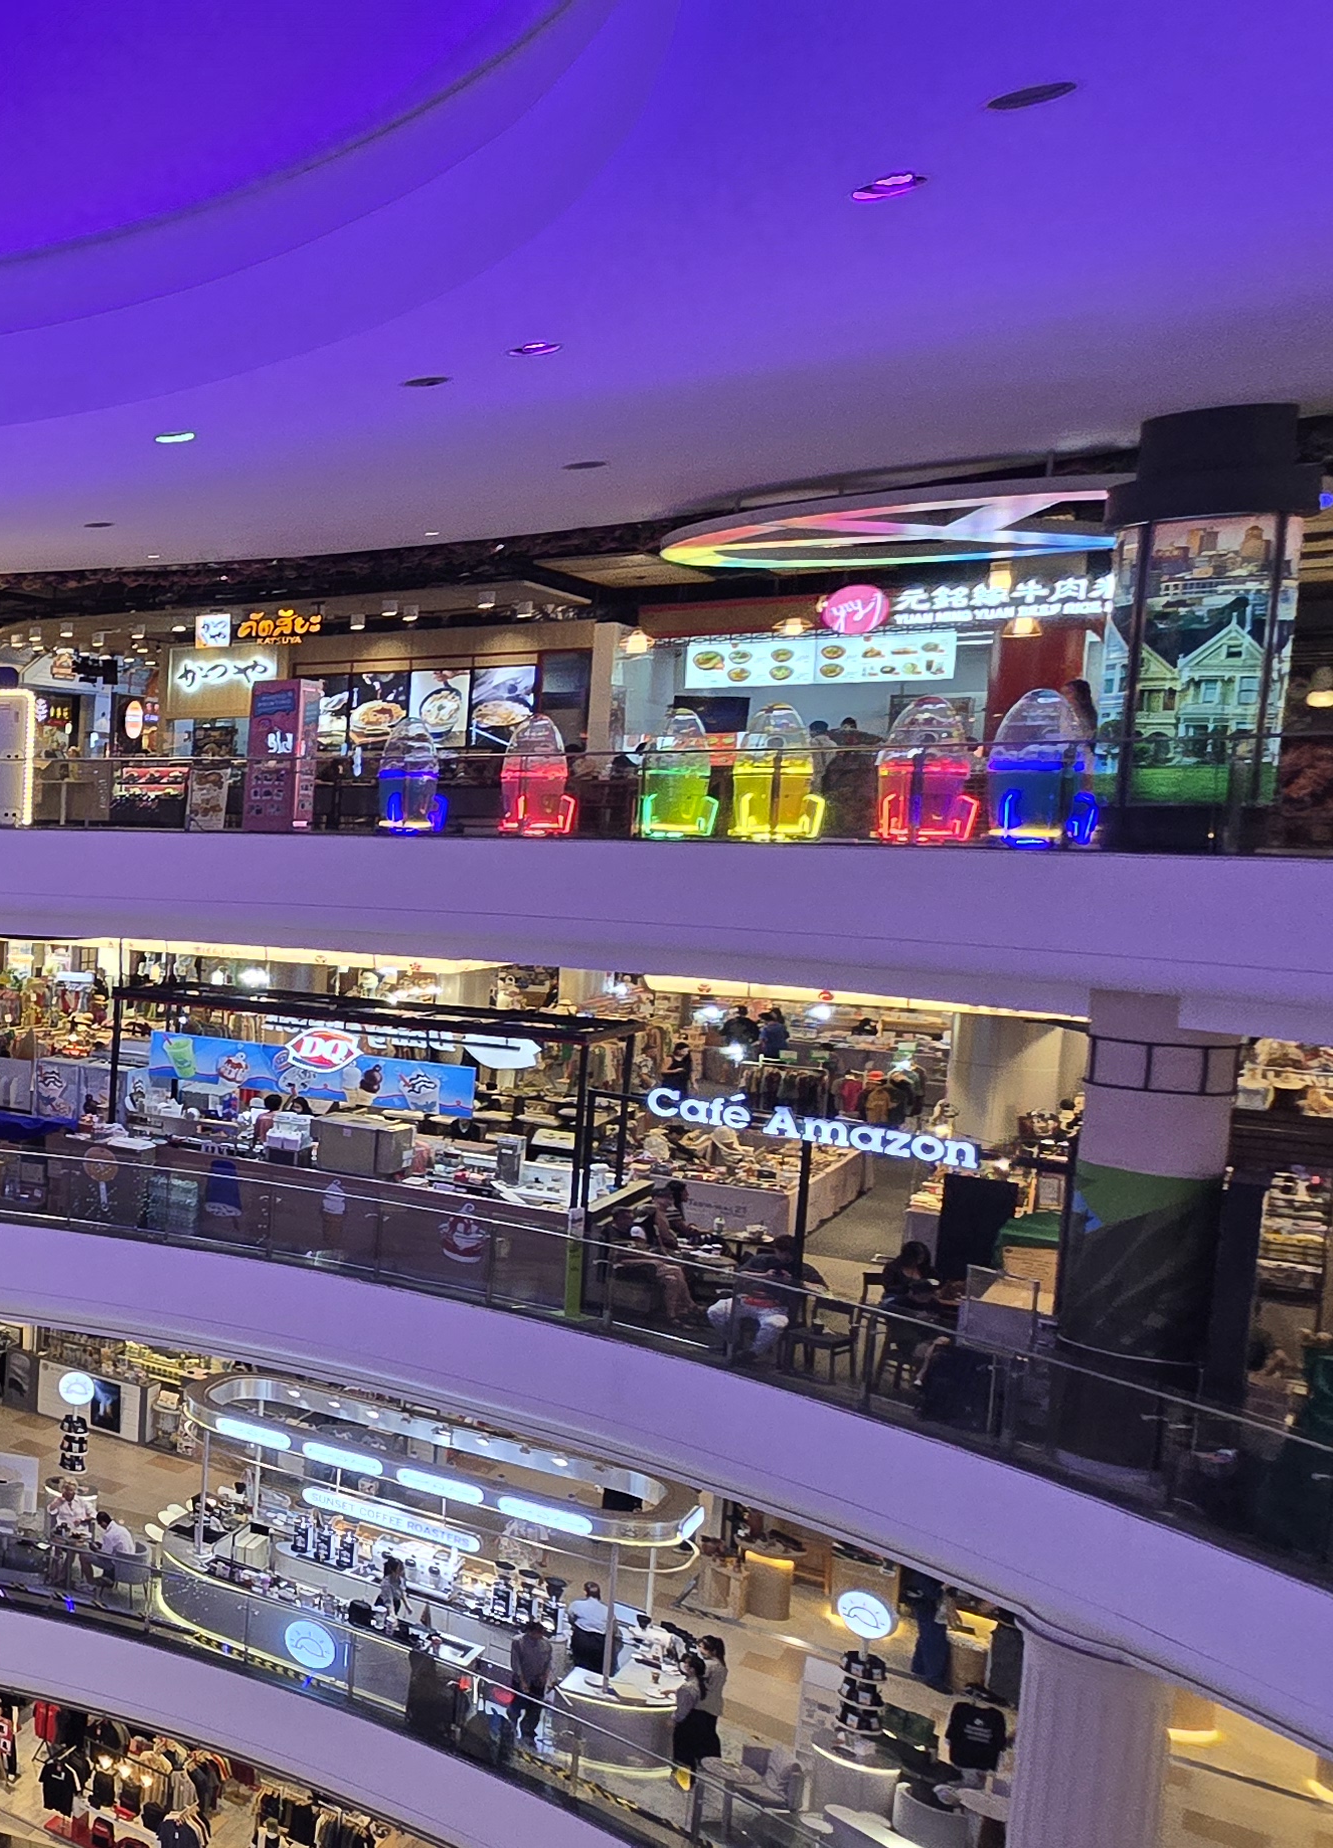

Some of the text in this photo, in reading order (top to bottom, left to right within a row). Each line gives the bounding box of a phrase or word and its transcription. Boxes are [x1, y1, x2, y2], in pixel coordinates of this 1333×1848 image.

[256, 636, 303, 645] KATSUYA
[177, 659, 269, 688] かつや
[298, 1034, 347, 1061] DQ
[647, 1087, 979, 1169] Café Amazon
[310, 1491, 471, 1548] SUNSET COFFEE ROASTERS
